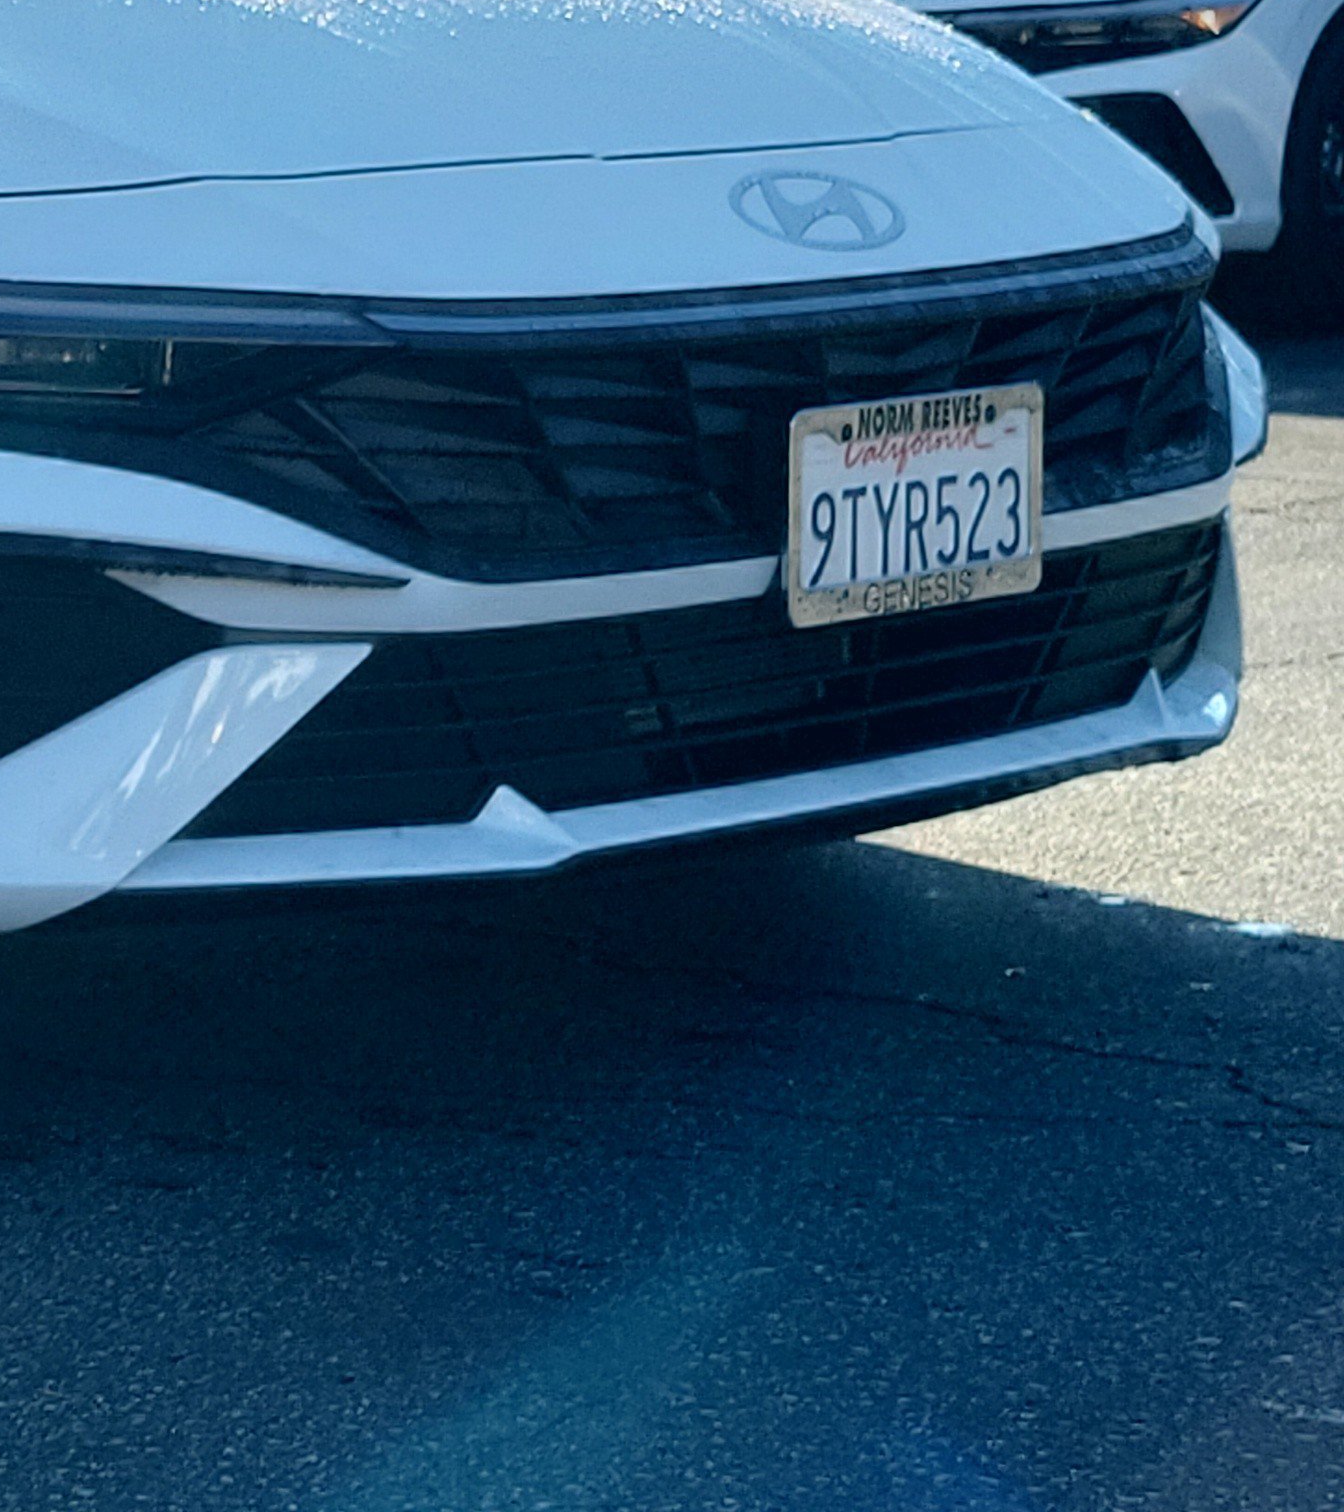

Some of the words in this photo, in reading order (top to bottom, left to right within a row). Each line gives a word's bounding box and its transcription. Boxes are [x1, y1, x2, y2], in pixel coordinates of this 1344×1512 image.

[857, 403, 914, 439] NORM
[921, 393, 983, 431] REEVES
[843, 425, 994, 475] California
[808, 467, 1022, 587] 9TYR523
[863, 569, 973, 615] GENESIS
